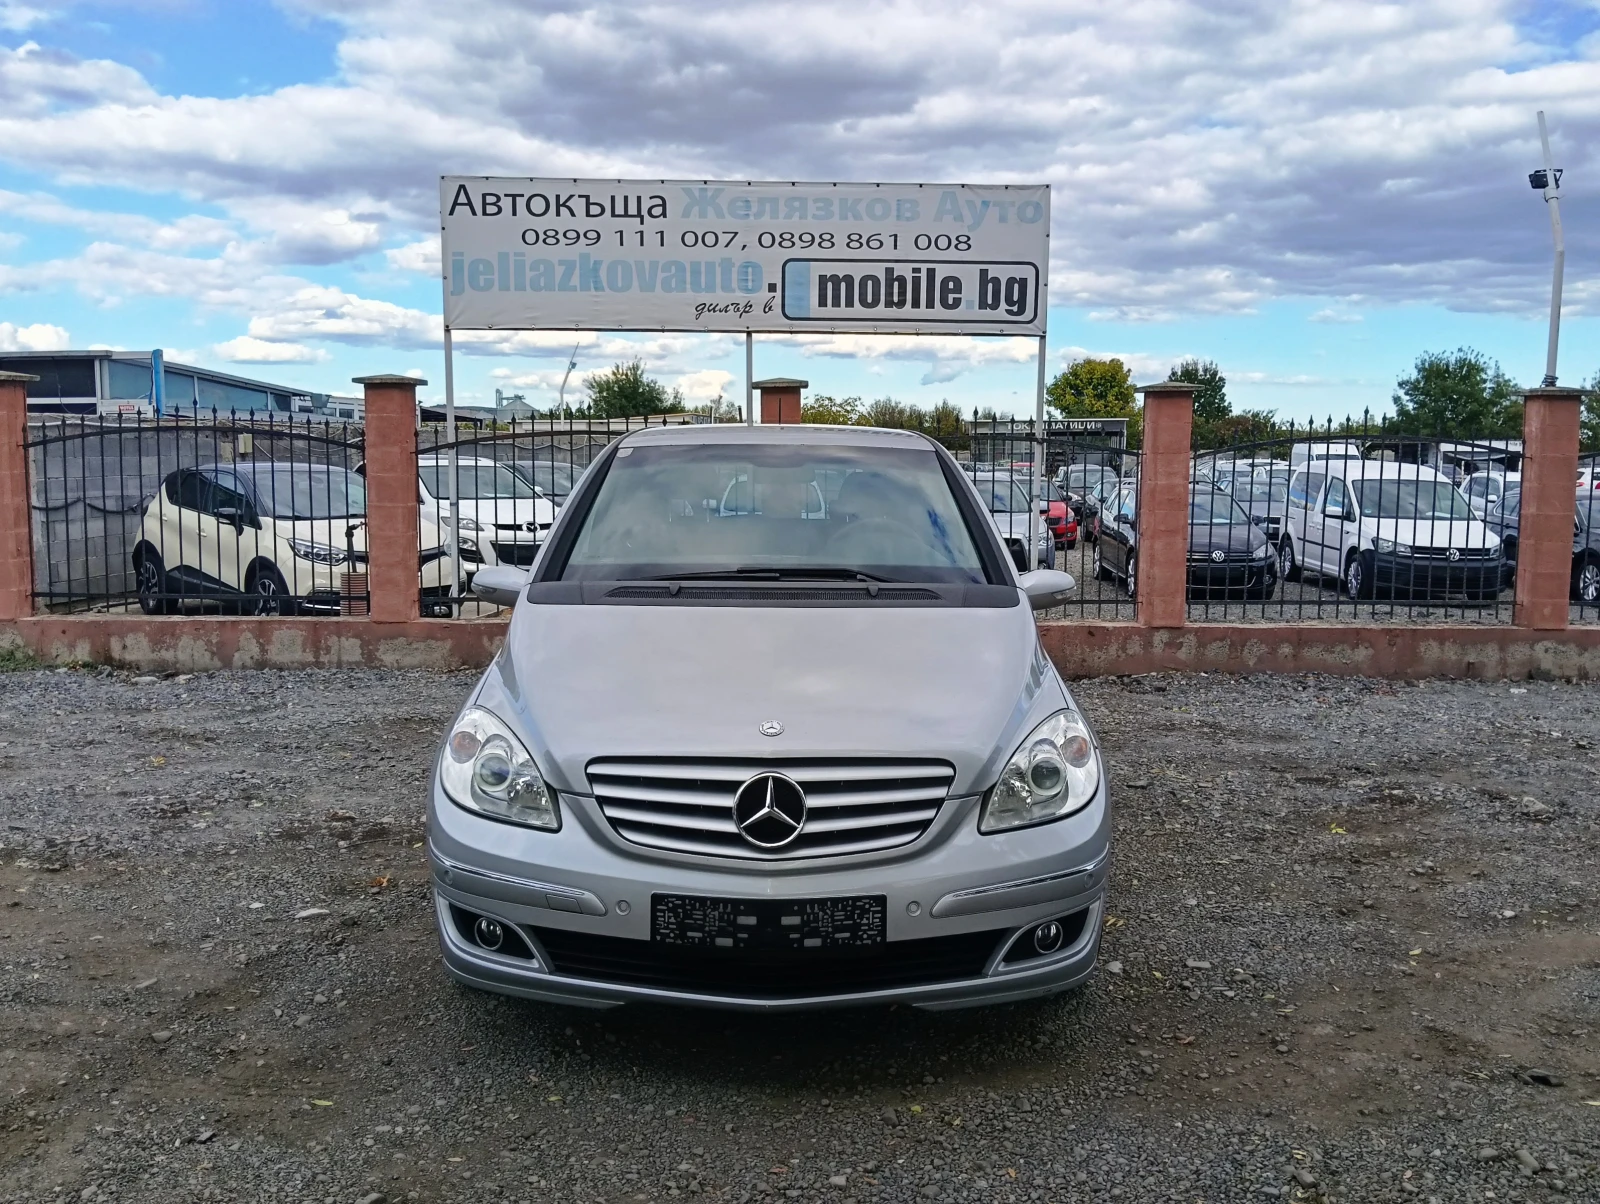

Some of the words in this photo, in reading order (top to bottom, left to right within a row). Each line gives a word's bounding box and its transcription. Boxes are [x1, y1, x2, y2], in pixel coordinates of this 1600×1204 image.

[448, 183, 668, 225] Автокъща
[681, 187, 921, 221] Желязков
[932, 190, 1044, 232] Ауто
[521, 228, 602, 247] 0899
[614, 229, 665, 247] 111
[680, 230, 748, 251] 007,
[757, 231, 836, 250] 0898
[845, 232, 900, 251] 861
[914, 233, 972, 252] 008
[694, 301, 754, 320] дилър
[763, 295, 775, 314] в
[817, 266, 1028, 317] mobile.bg
